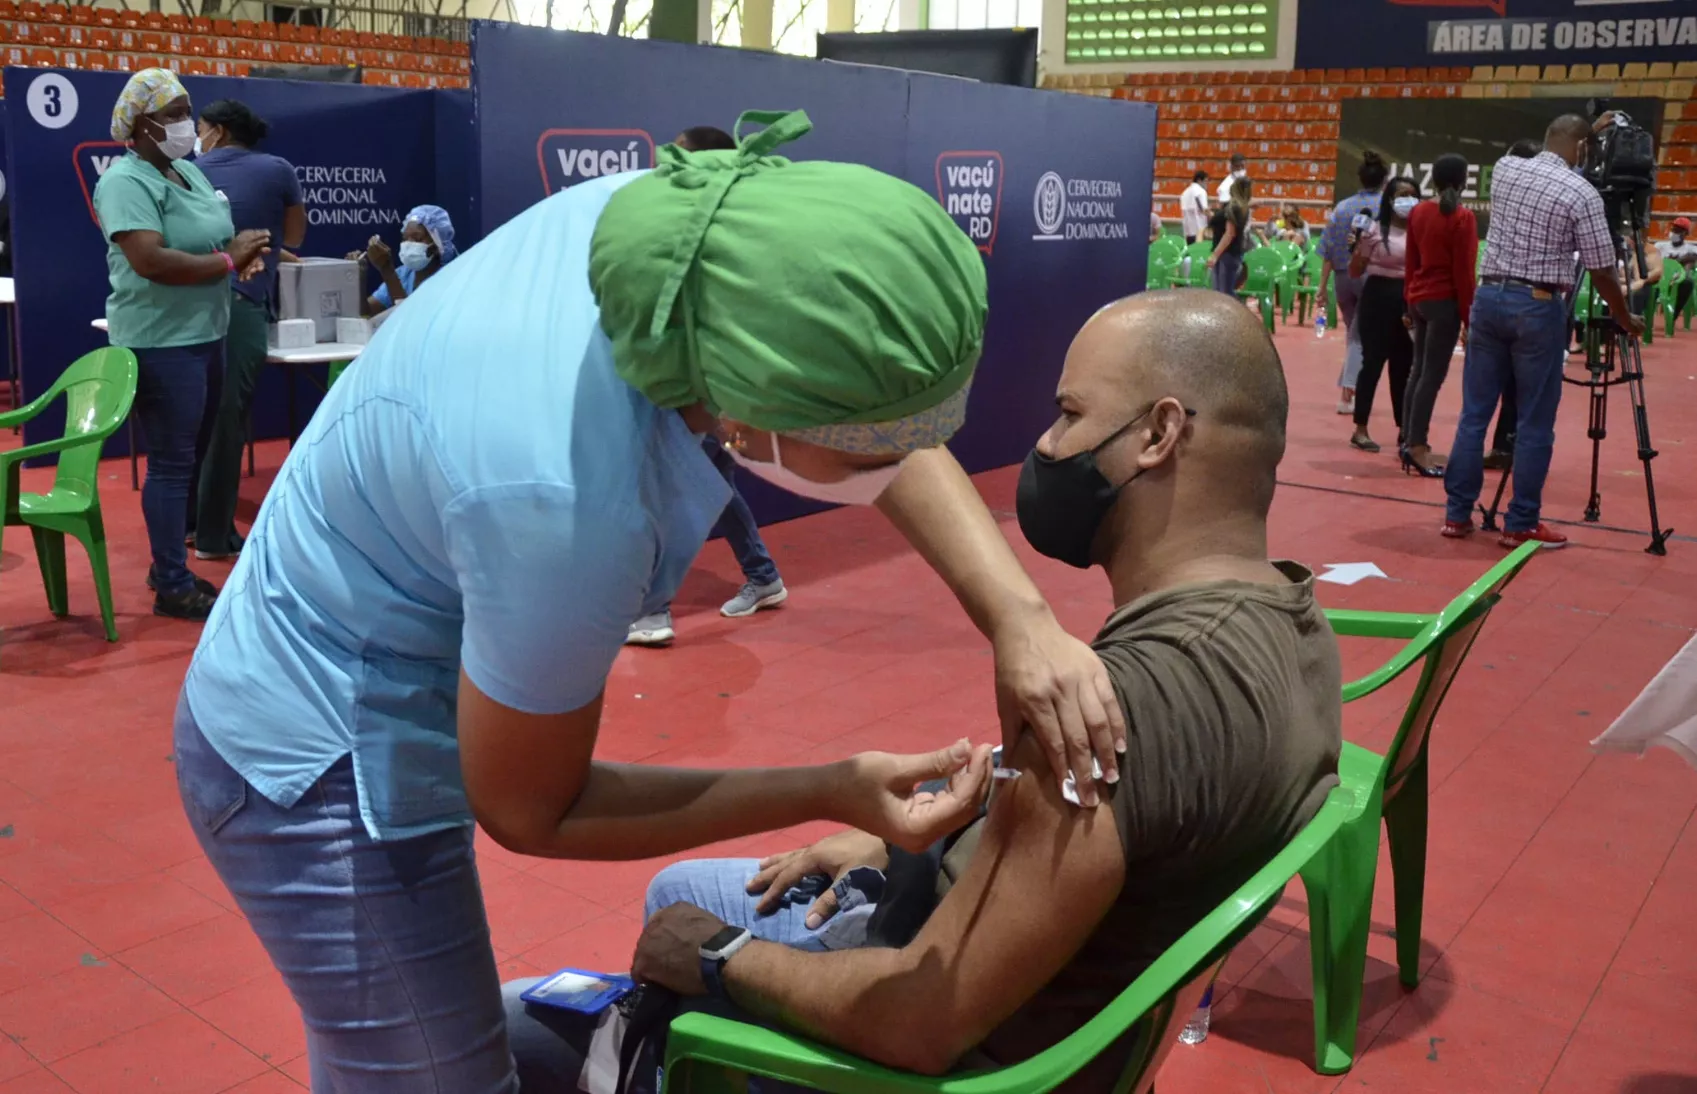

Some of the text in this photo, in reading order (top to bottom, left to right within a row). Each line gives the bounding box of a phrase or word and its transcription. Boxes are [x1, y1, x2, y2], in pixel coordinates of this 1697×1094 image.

[1433, 21, 1504, 52] ÁREA
[1510, 23, 1548, 50] DE
[43, 85, 62, 117] 3
[557, 141, 638, 177] vacú
[295, 166, 386, 184] CERVECERIA
[947, 160, 994, 188] vacú
[1067, 179, 1122, 198] CERVECERIA
[948, 190, 992, 214] nate
[1065, 201, 1116, 219] NACIONAL
[303, 208, 401, 225] OMINICANA
[970, 217, 992, 239] RD
[1065, 223, 1128, 240] DOMINICANA
